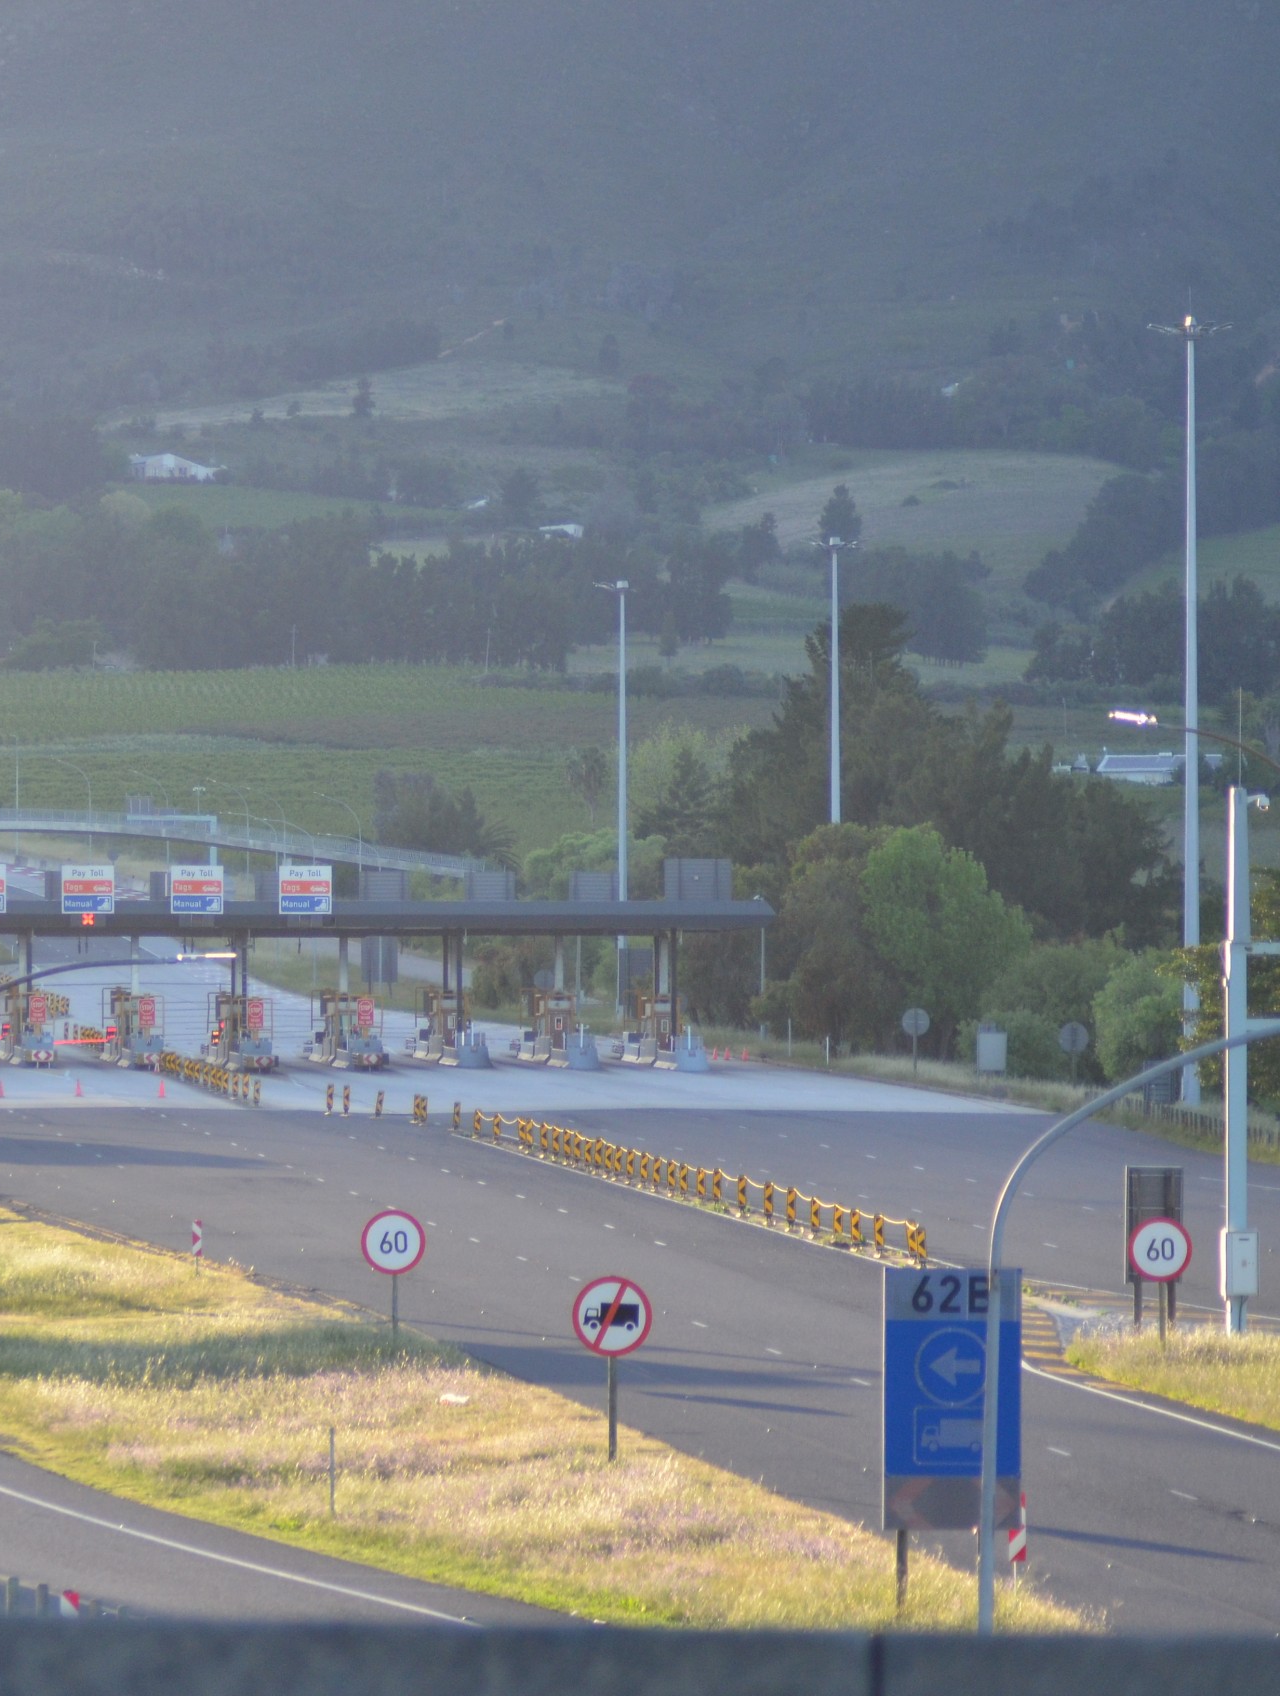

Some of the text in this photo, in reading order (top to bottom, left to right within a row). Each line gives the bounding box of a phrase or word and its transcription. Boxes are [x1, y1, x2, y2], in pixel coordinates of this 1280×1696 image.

[72, 869, 104, 878] Pay Toll
[181, 869, 213, 878] Pay Toll
[289, 869, 321, 878] Pay Toll
[65, 882, 83, 892] Tags
[174, 882, 192, 892] Tags
[282, 882, 300, 892] Tags
[64, 900, 92, 908] Manual
[173, 900, 201, 908] Manual
[282, 900, 310, 908] Manual
[380, 1230, 408, 1254] 60
[1146, 1238, 1175, 1262] 60
[911, 1275, 989, 1314] 62E
